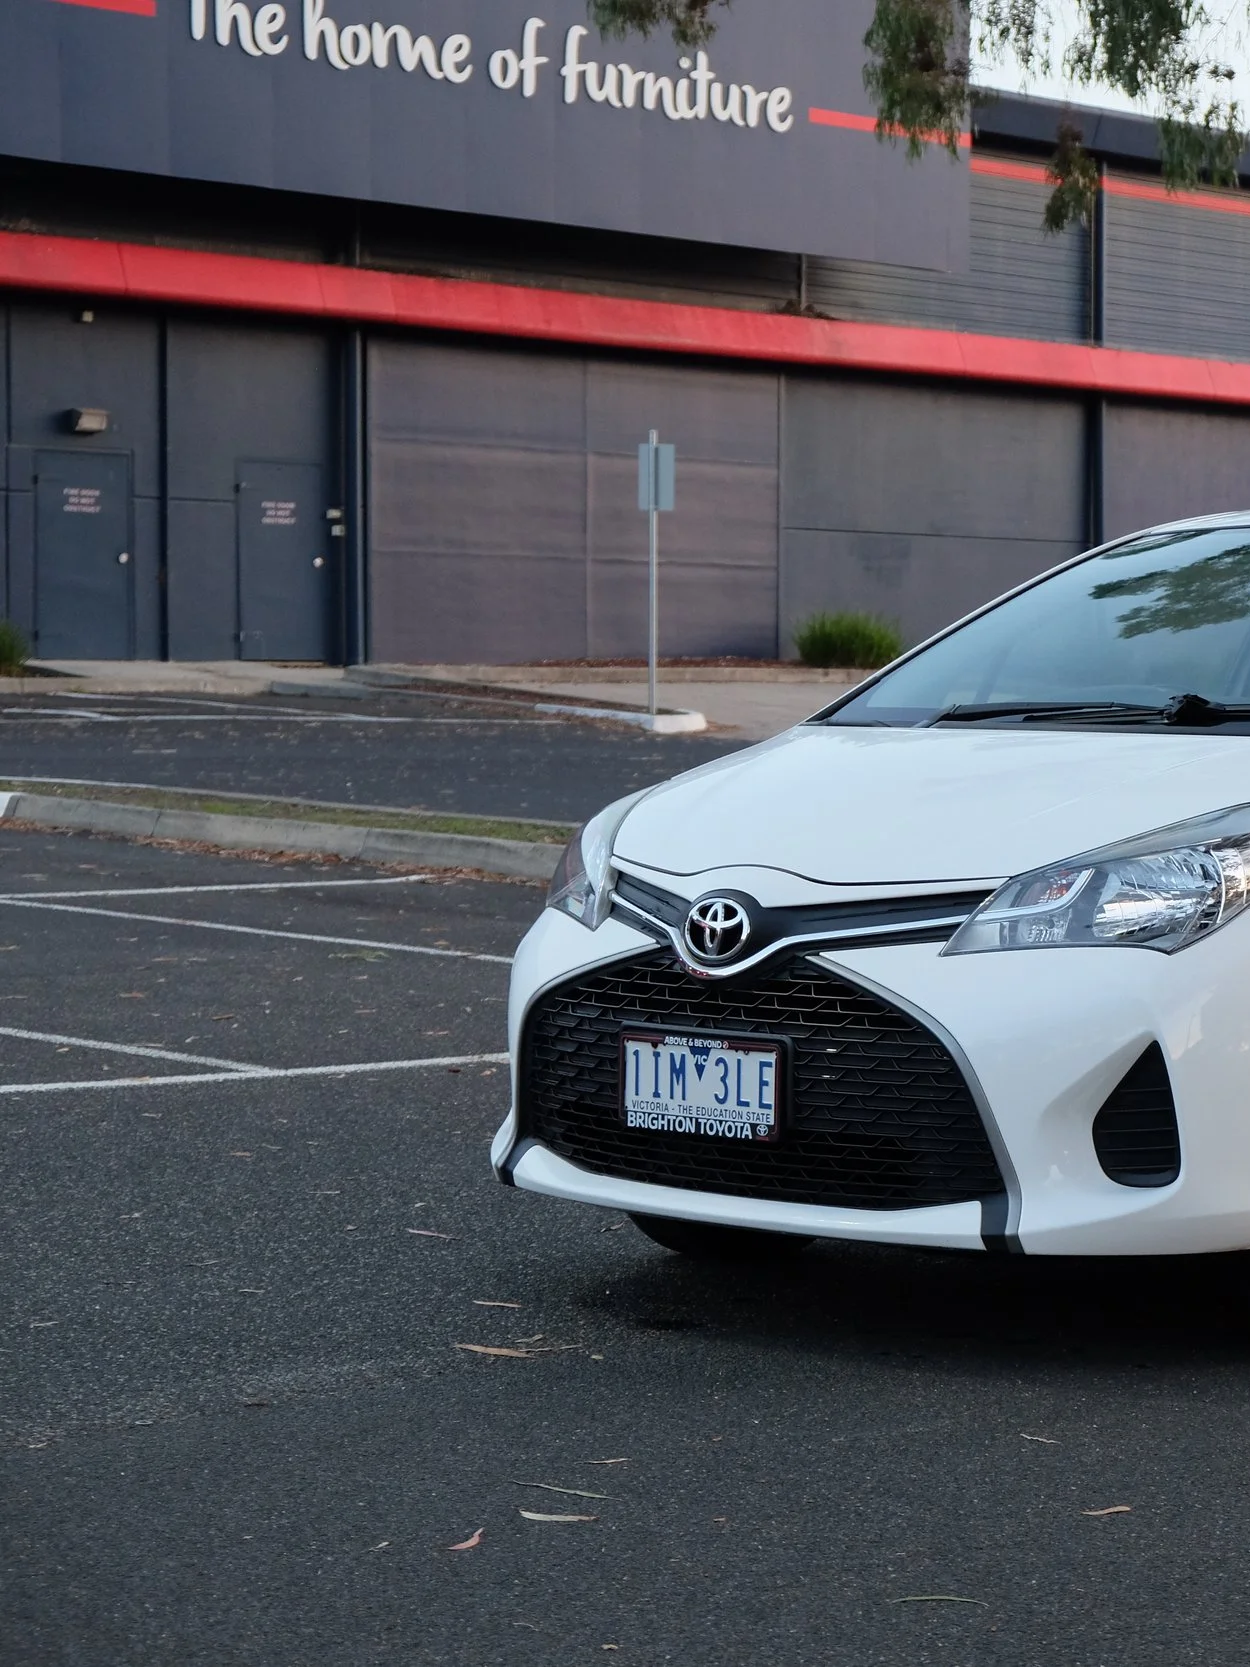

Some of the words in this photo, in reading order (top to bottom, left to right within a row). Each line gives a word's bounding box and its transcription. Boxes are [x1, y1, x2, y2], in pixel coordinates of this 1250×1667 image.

[303, 0, 473, 84] home
[488, 16, 550, 98] of
[560, 24, 794, 133] furniture
[664, 1035, 688, 1046] ABOVE
[688, 1038, 694, 1046] &
[694, 1038, 722, 1049] BEYOND
[693, 1054, 708, 1065] VIC
[713, 1056, 773, 1110] 3LE
[631, 1099, 669, 1112] VICTORIA
[678, 1104, 693, 1115] THE
[696, 1106, 743, 1120] EDUCATION
[745, 1111, 771, 1123] STATE
[627, 1111, 696, 1134] BRIGHTON
[698, 1118, 753, 1140] TOYOTA
